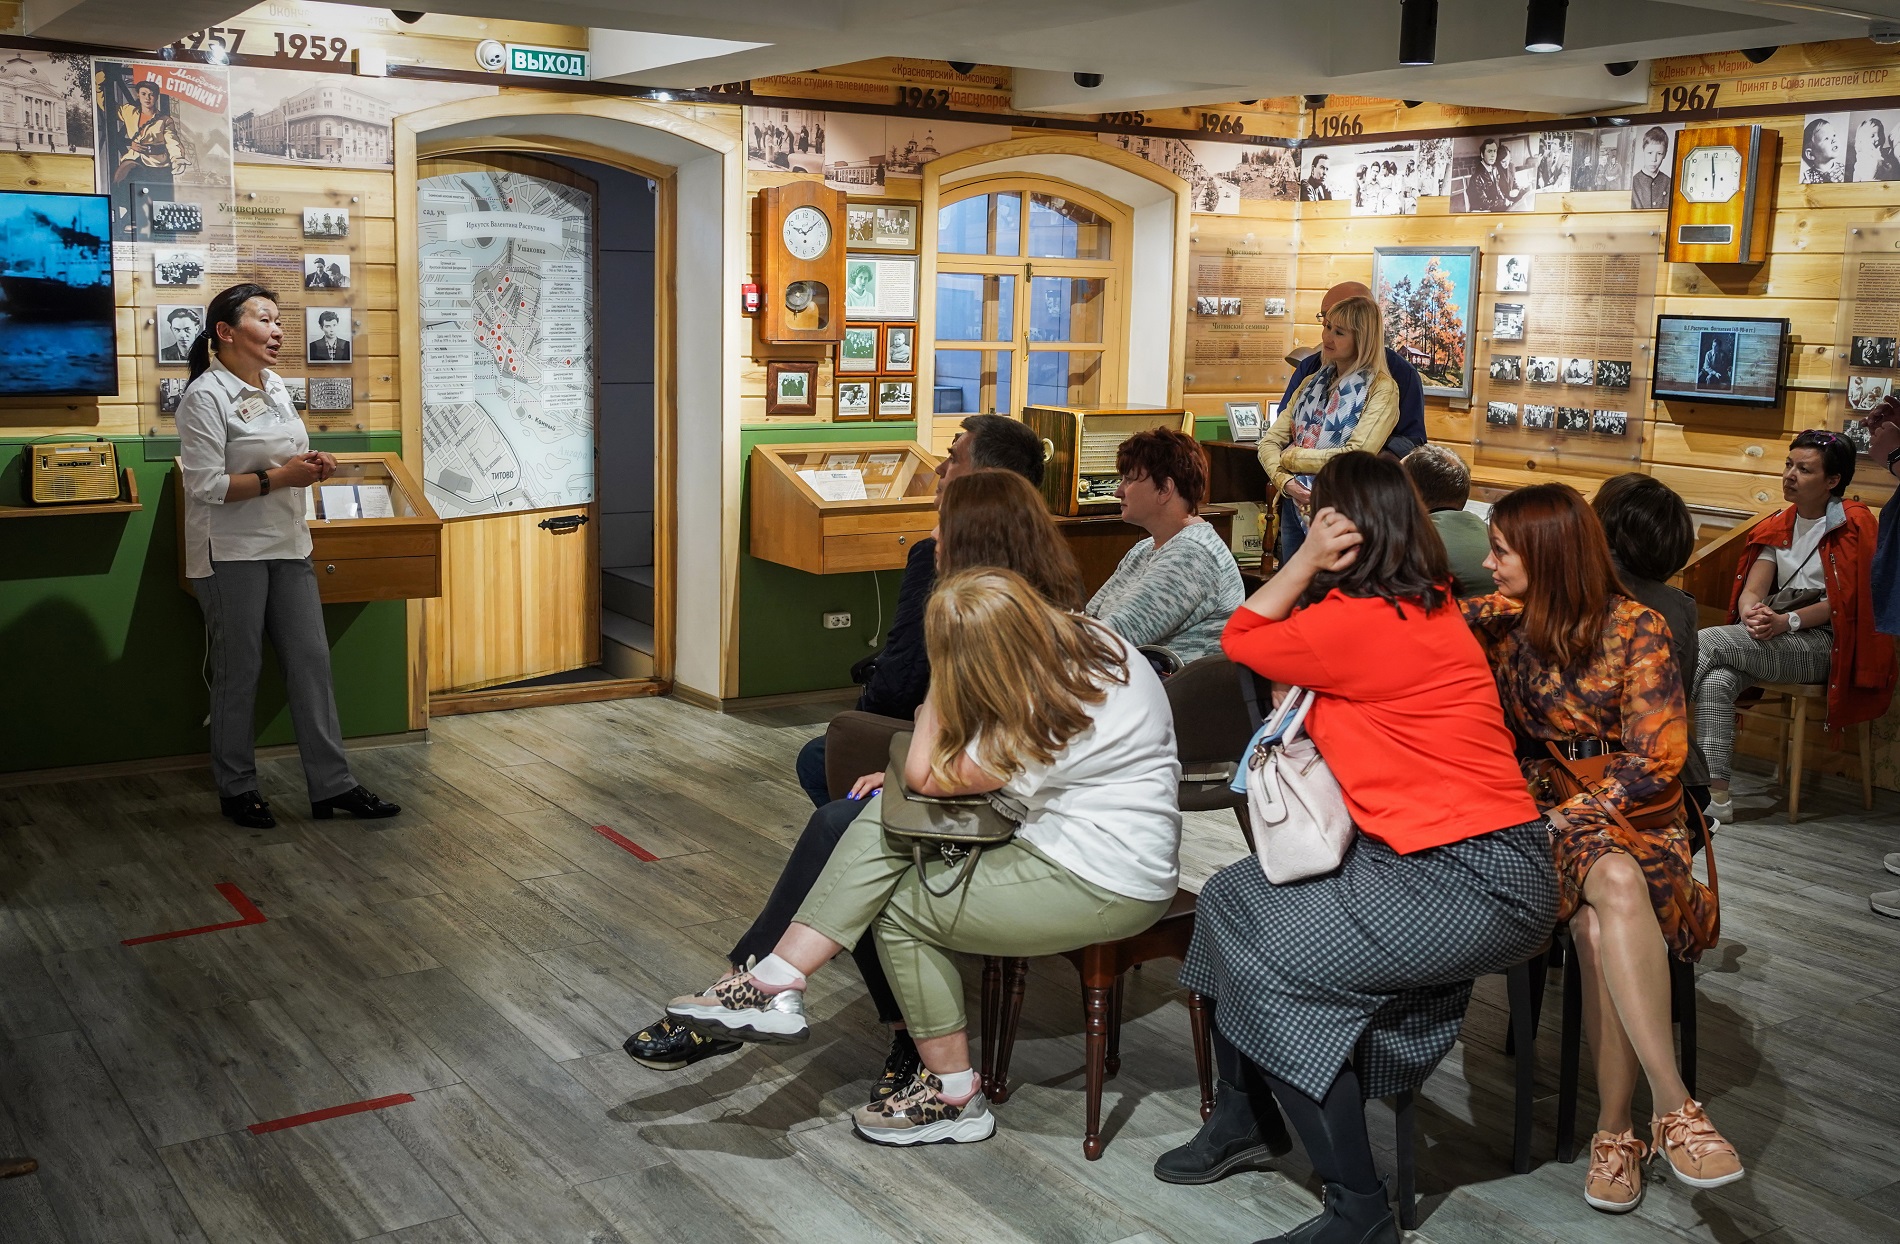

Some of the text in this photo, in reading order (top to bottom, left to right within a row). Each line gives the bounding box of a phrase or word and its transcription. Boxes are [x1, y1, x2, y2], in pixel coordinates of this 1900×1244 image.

[274, 32, 347, 62] 1959
[514, 51, 582, 75] ВЫХОД
[891, 63, 954, 80] «Красноярский
[1658, 59, 1754, 79] «Деньги для Марии»
[146, 71, 223, 108] НА СТРОЙКИ!
[804, 77, 832, 89] студия
[835, 80, 889, 93] телевидения
[1736, 69, 1888, 95] Принят в Союз писателей СССР
[898, 86, 949, 108] 1962
[947, 87, 1012, 110] Красноярск
[1660, 83, 1720, 112] 1967
[1441, 106, 1469, 118] Переход
[1200, 113, 1244, 134] 1966
[1322, 114, 1363, 138] 1966
[219, 202, 286, 216] Университет
[466, 220, 546, 232] Иркутск Валентина Распутина
[517, 244, 546, 255] Ушаковка
[1245, 323, 1269, 331] семинар
[491, 470, 514, 480] ТИТОВО
